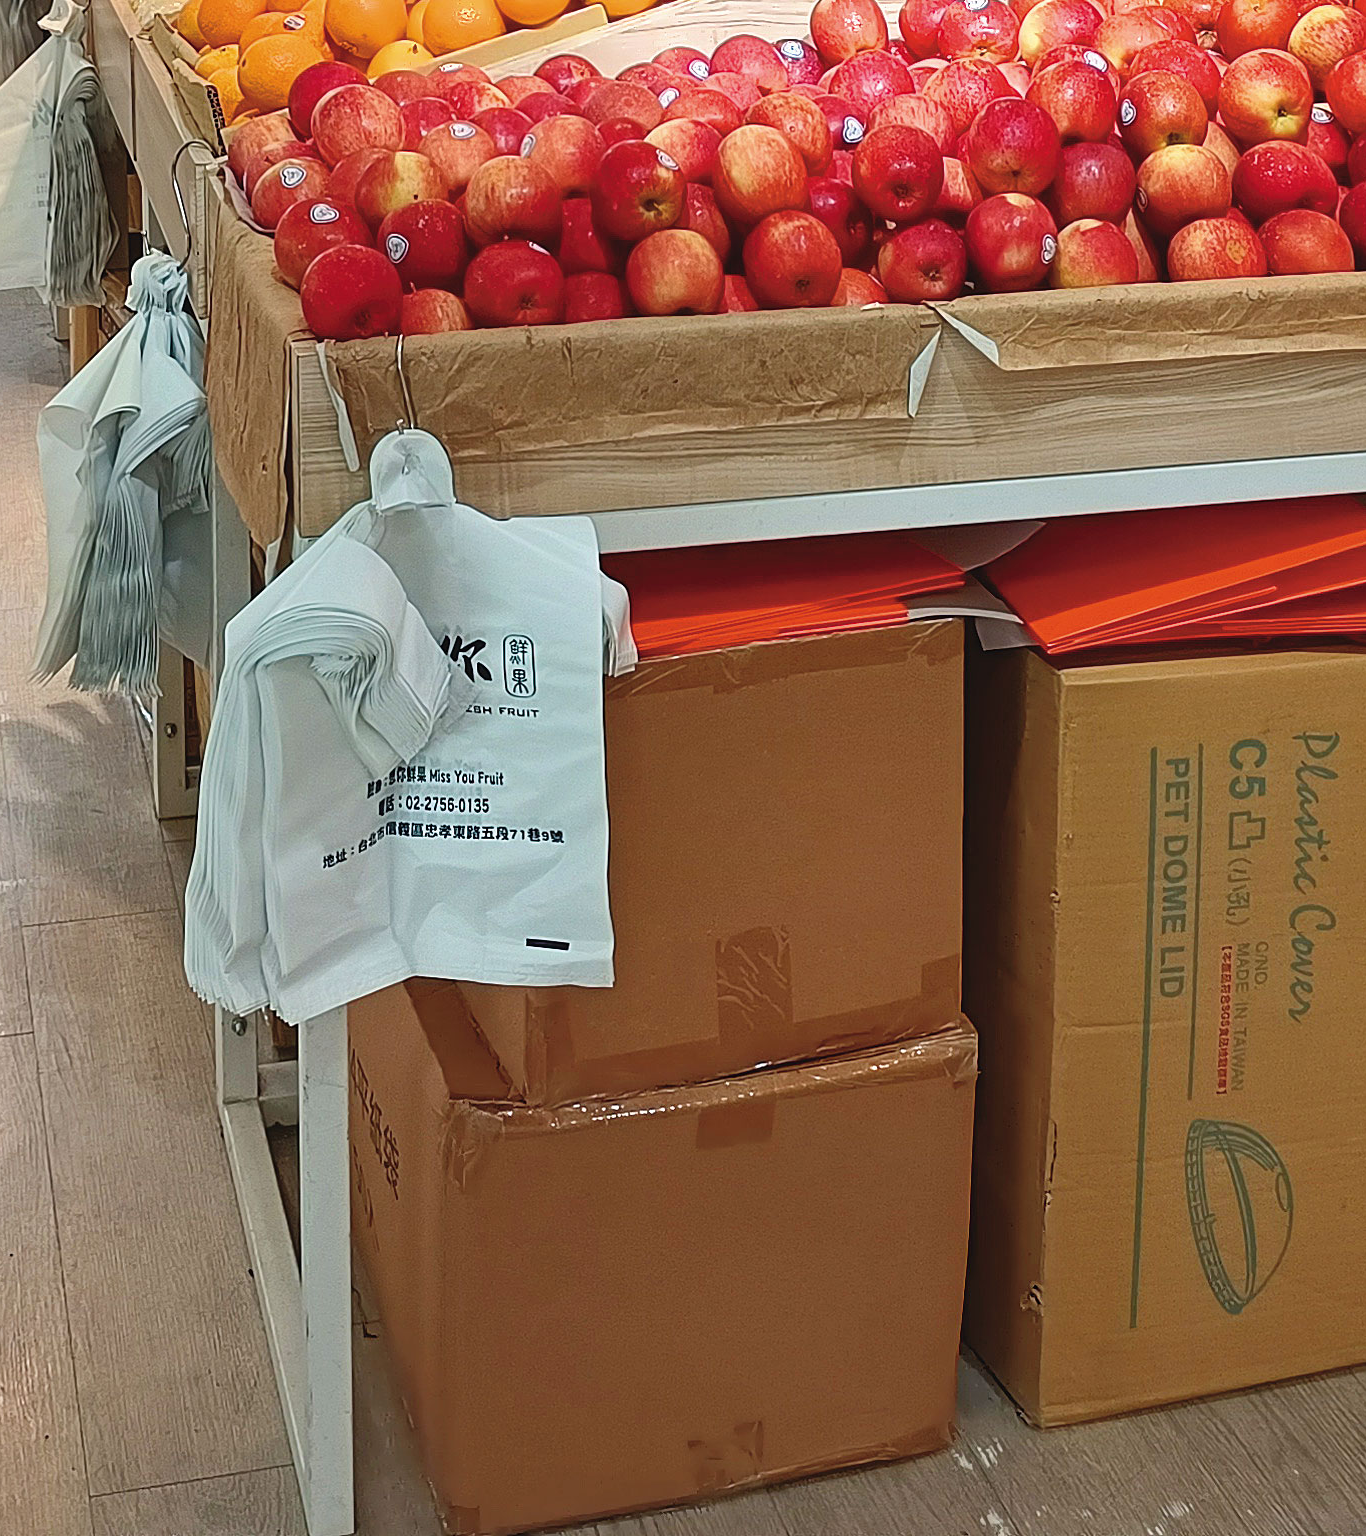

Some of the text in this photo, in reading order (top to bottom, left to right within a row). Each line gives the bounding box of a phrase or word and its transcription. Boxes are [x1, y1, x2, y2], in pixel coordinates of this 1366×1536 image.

[509, 638, 529, 694] 鮮果
[499, 707, 539, 718] FRUIT
[429, 768, 451, 784] Miss
[454, 769, 475, 784] You
[477, 770, 504, 786] Fruit
[1228, 738, 1268, 801] C5
[1159, 757, 1191, 999] PET DOME LID
[1288, 730, 1340, 1024] Plastic Cover
[1230, 942, 1251, 1092] MADE IN TAIWAN
